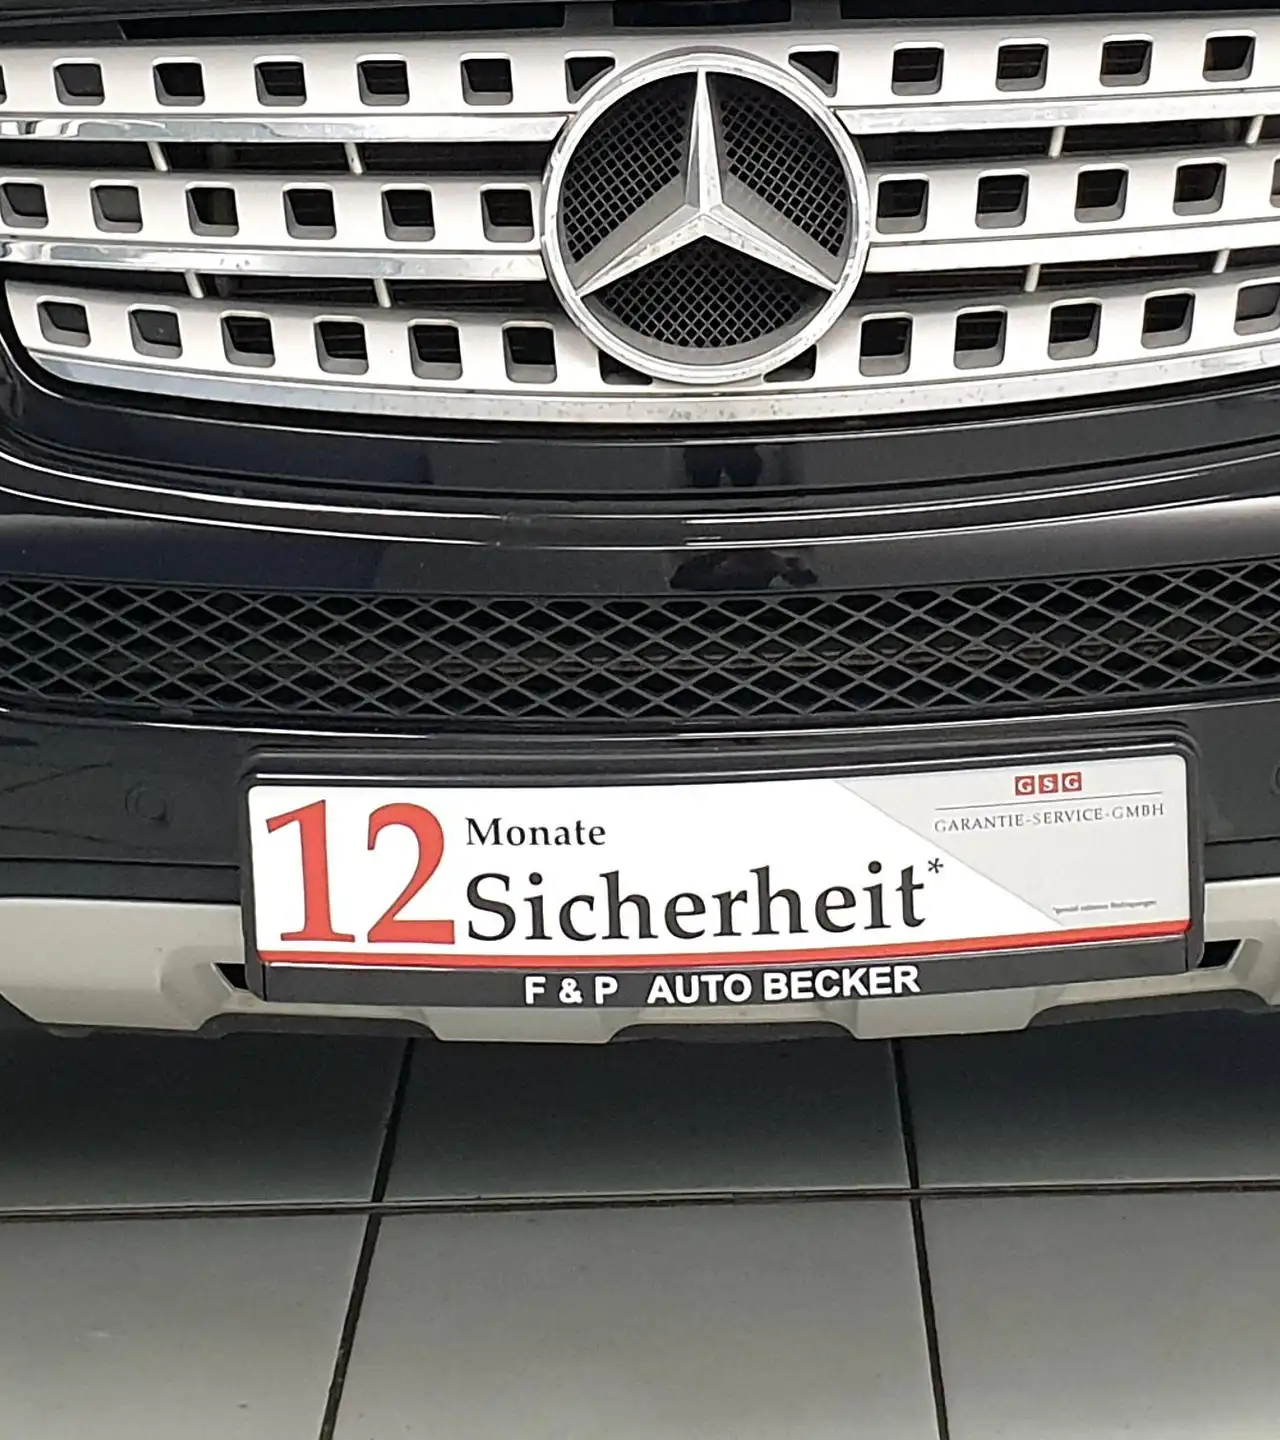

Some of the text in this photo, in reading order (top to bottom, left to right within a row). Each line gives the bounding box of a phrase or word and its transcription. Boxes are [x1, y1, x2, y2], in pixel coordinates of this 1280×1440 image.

[1015, 772, 1082, 796] GSG
[465, 817, 607, 847] Monate
[266, 800, 456, 945] 12
[525, 965, 922, 1005] F & P AUTO BECKER
